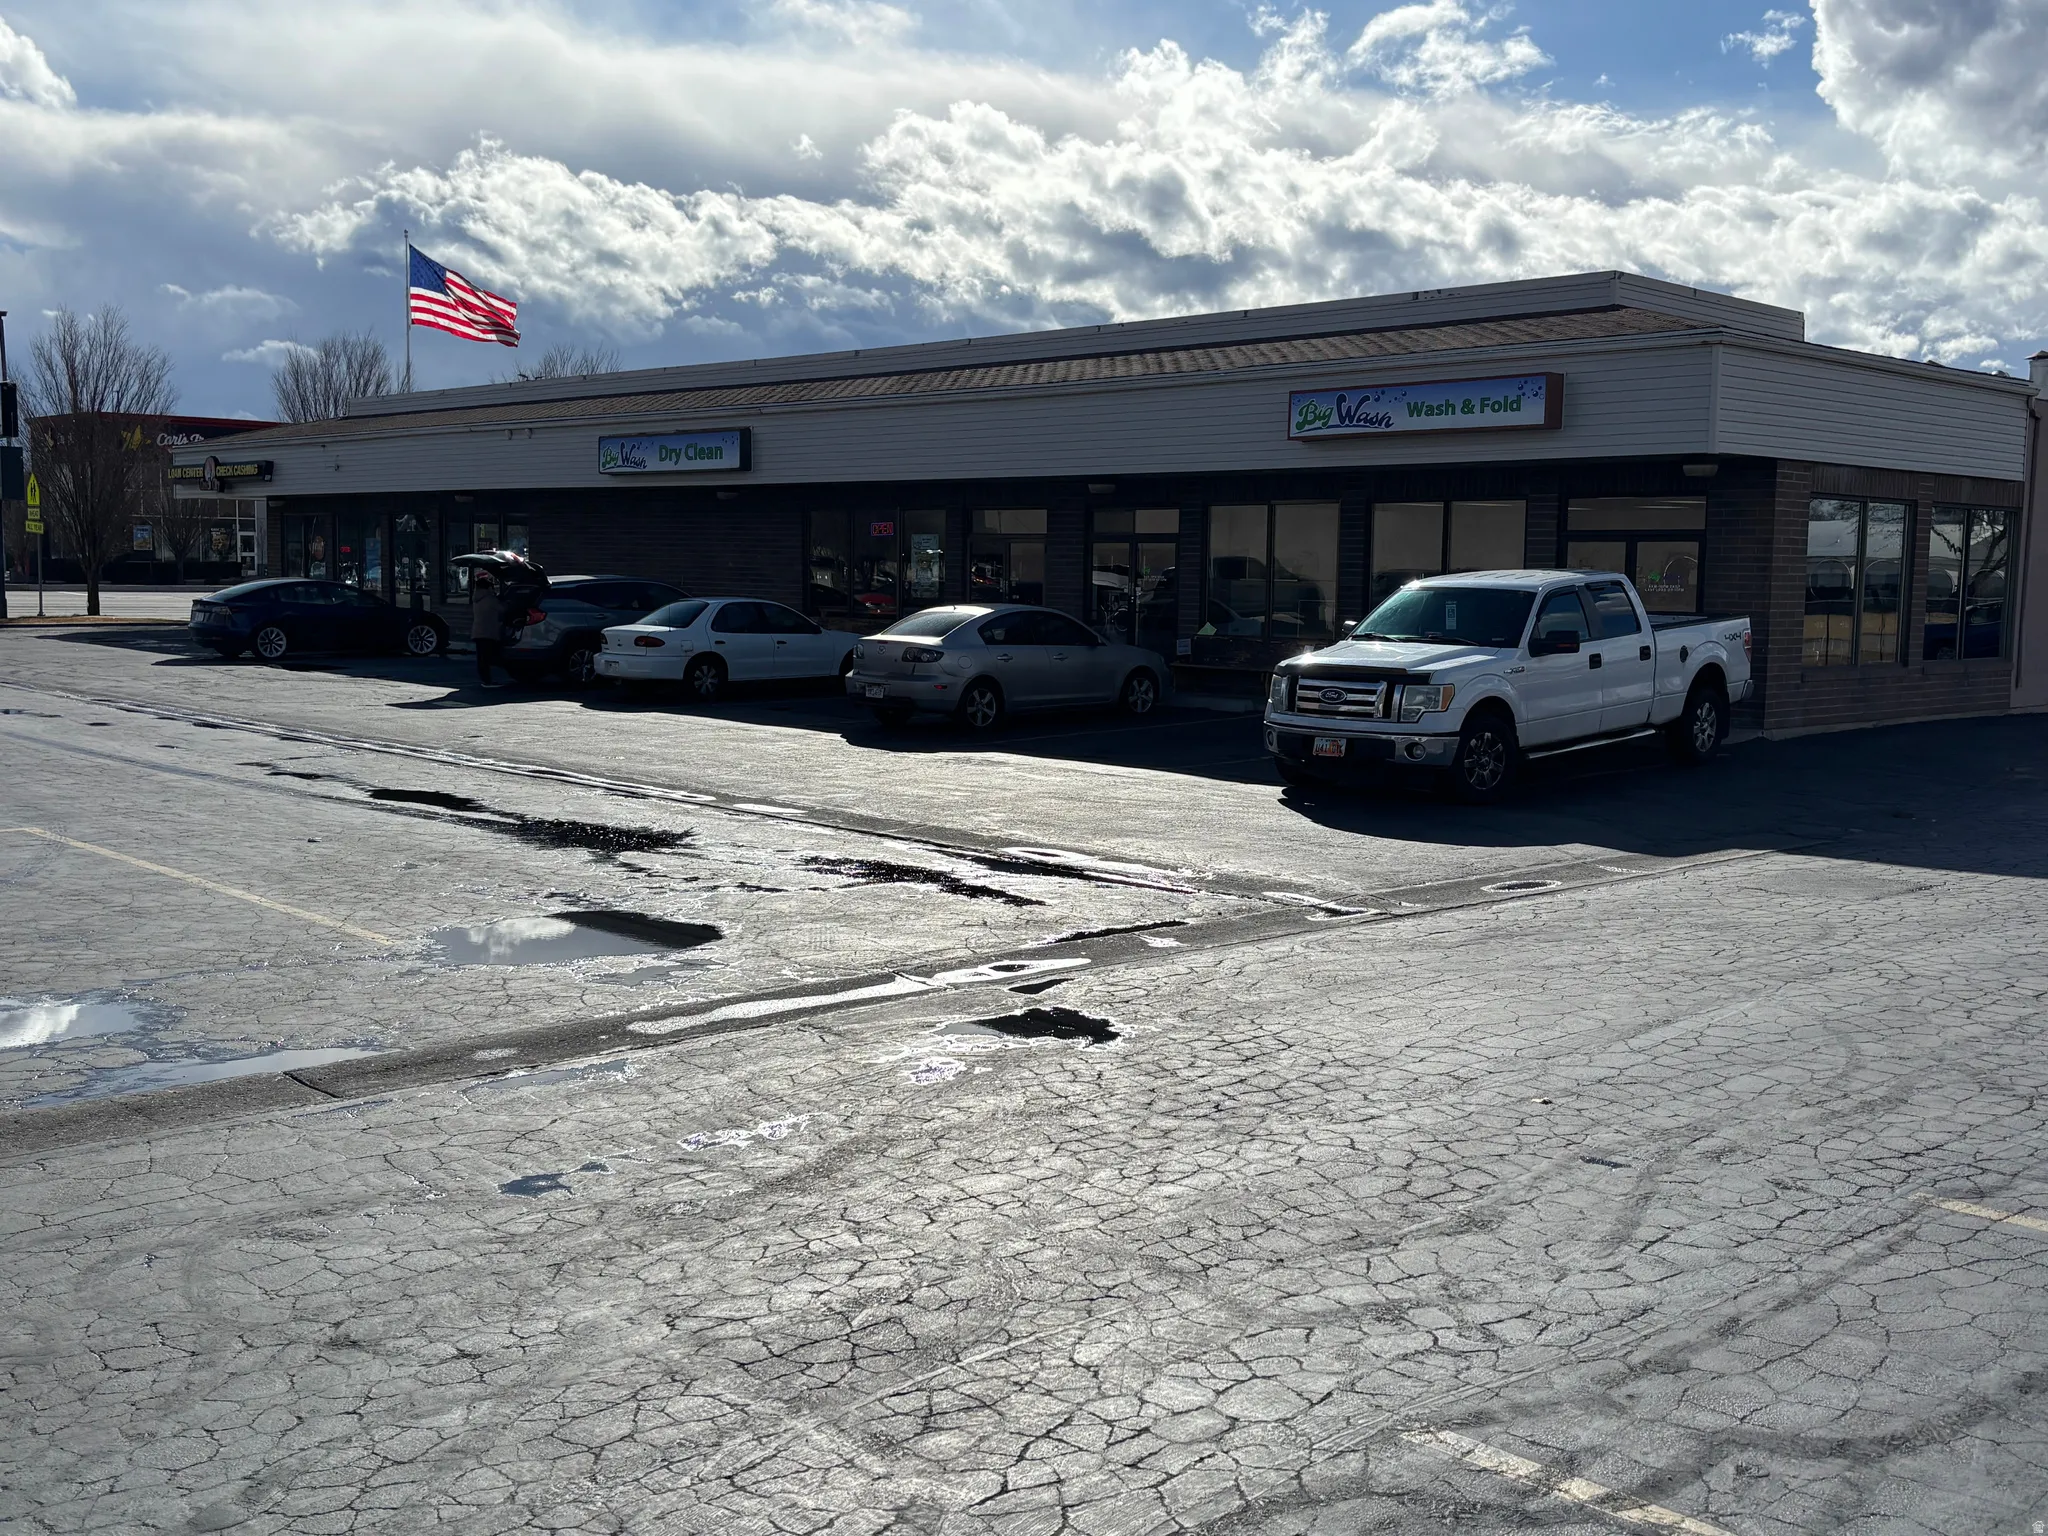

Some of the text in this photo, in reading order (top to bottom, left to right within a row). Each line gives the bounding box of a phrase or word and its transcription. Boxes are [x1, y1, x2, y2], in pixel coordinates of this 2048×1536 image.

[1295, 393, 1395, 431] Big Wash
[1406, 395, 1522, 417] Wash & Fold
[156, 433, 189, 446] Carl's
[601, 442, 648, 469] Big Wash
[658, 443, 723, 466] Dry Clean
[168, 467, 204, 479] LOAN CENTER
[216, 463, 258, 477] CHECK CASHING
[872, 523, 893, 534] OPEN
